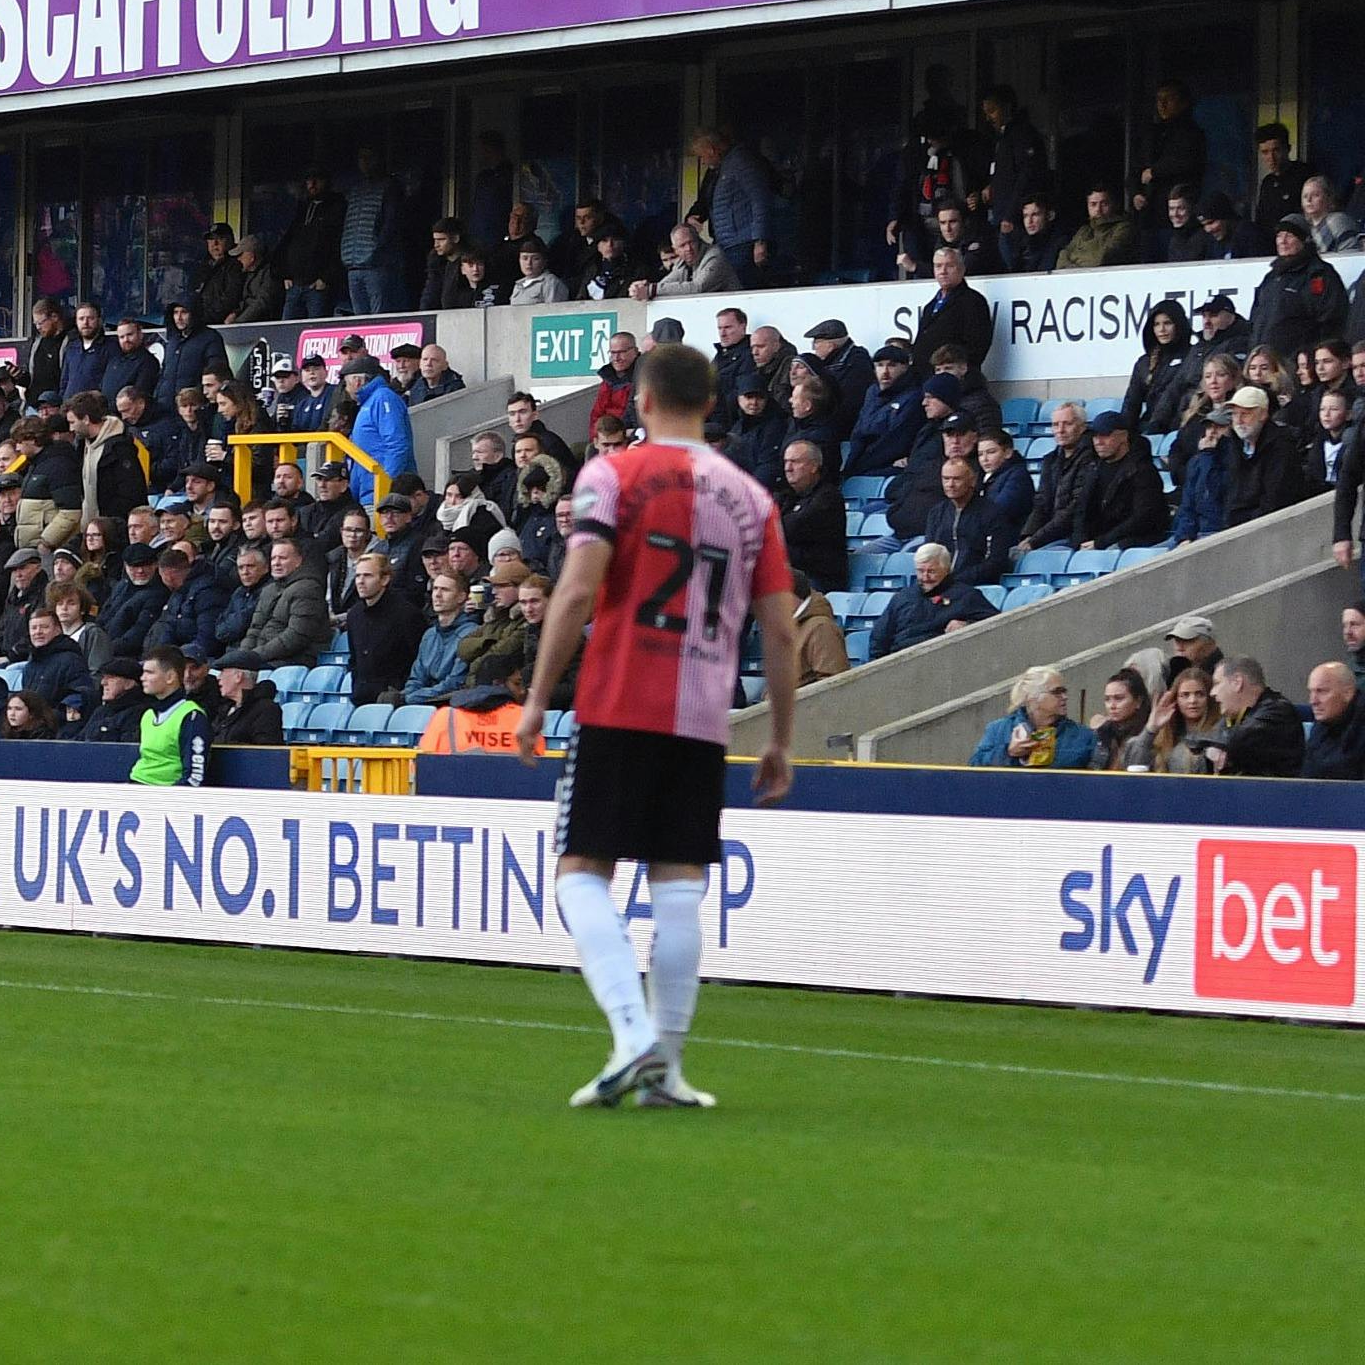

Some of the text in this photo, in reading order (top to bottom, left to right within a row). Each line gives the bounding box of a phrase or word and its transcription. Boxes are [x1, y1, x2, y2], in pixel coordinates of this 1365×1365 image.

[535, 330, 584, 363] EXIT
[14, 805, 142, 909] UK'S
[163, 813, 299, 919] NO.1
[328, 821, 570, 936] BETTIN
[1059, 844, 1341, 985] sky bet
